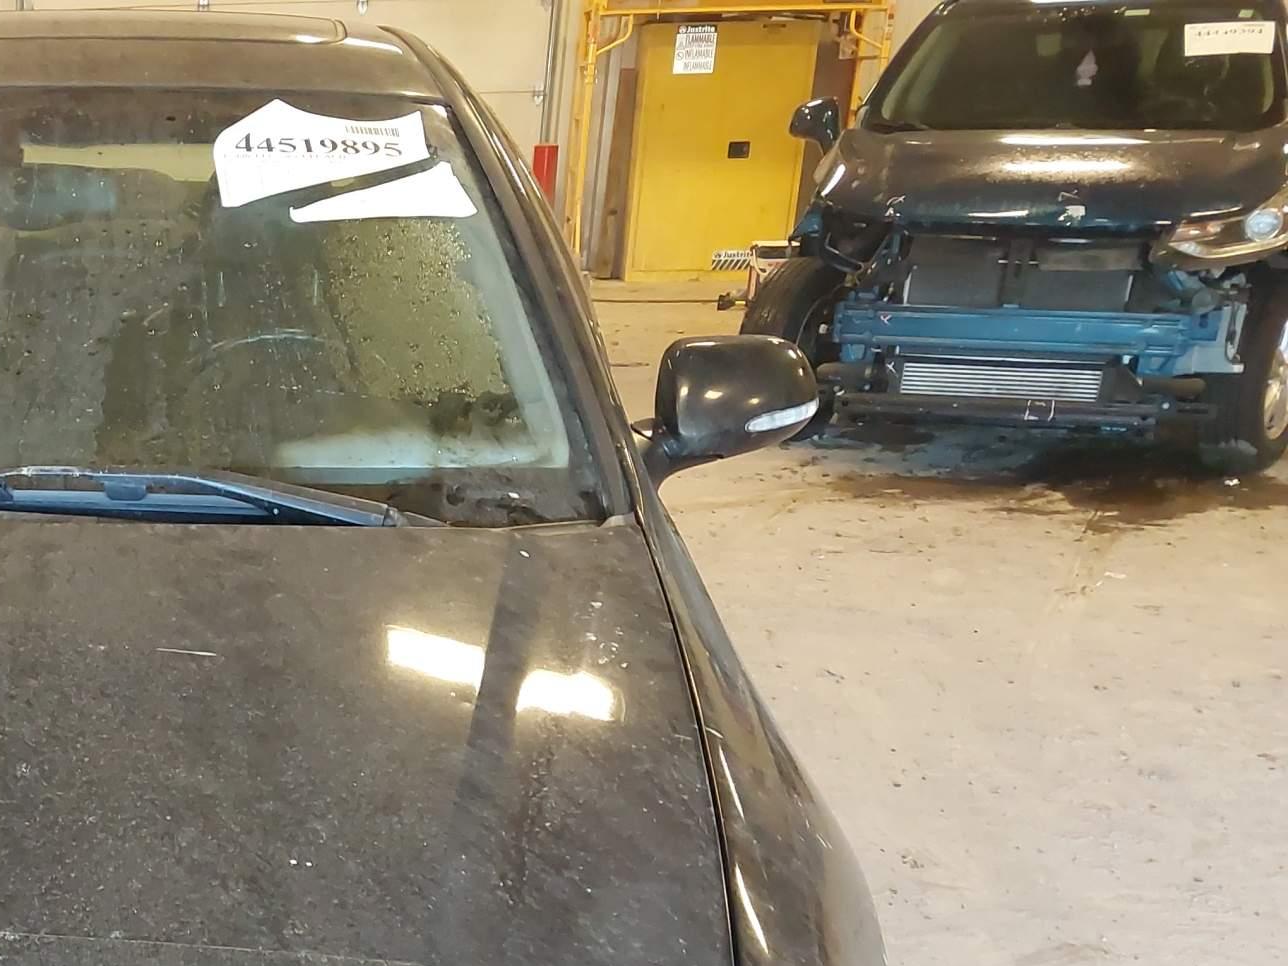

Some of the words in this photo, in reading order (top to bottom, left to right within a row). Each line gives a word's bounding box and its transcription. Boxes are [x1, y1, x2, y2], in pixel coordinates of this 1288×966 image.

[687, 25, 716, 33] Justrite
[234, 132, 403, 157] 44519895
[723, 250, 751, 259] Justrit
